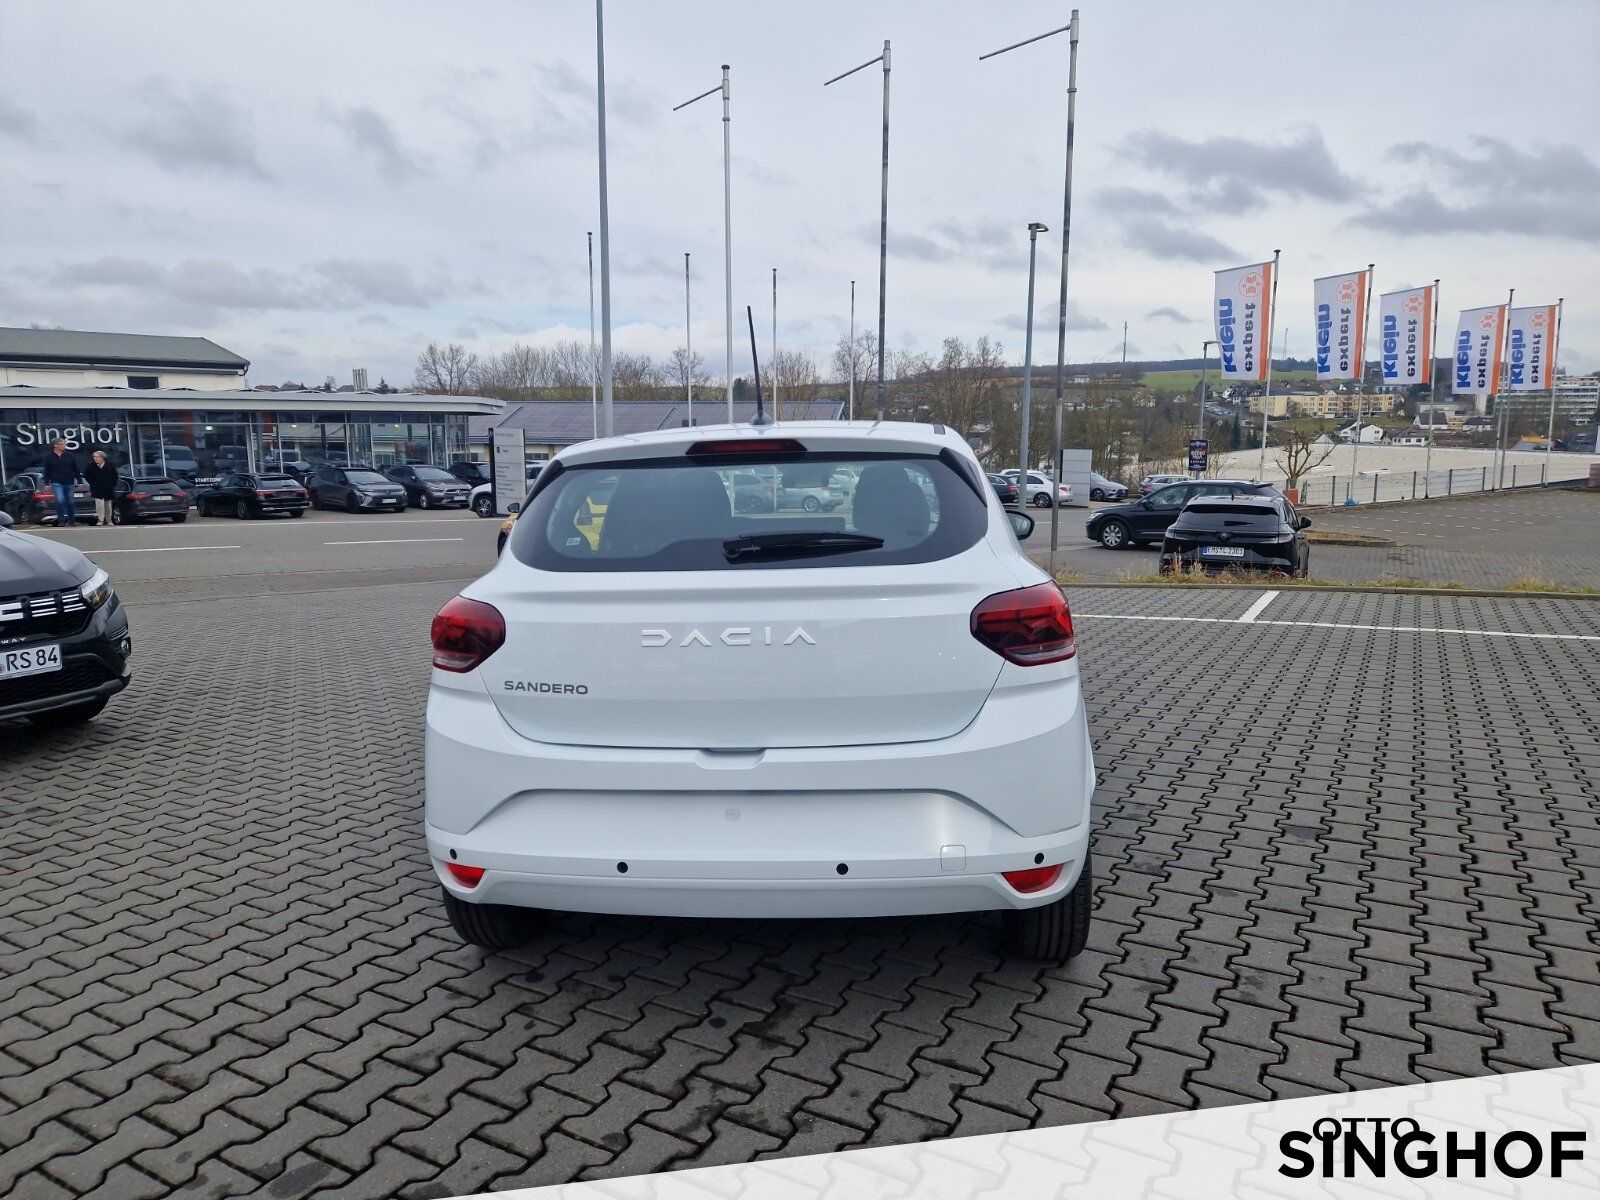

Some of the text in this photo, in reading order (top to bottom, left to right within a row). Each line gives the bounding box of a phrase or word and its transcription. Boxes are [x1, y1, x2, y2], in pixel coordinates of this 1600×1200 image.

[16, 422, 123, 450] Singhof
[641, 626, 816, 647] DACIA
[6, 647, 58, 671] RS 84
[504, 680, 588, 695] SANDERO
